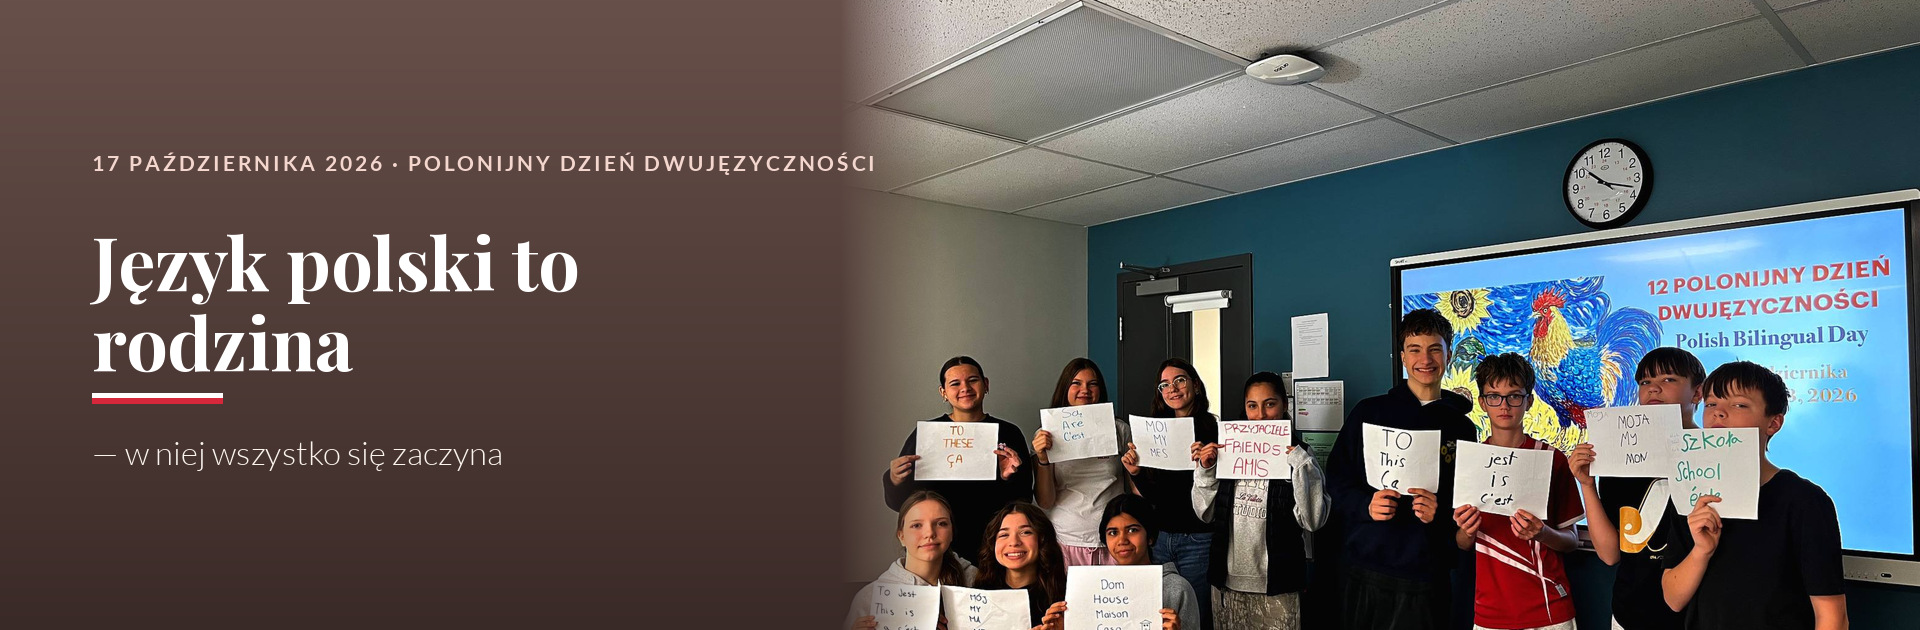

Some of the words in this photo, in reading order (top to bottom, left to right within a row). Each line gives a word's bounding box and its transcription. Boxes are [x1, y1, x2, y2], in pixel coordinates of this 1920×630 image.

[1598, 148, 1611, 159] 12
[1618, 148, 1624, 159] 1
[1584, 155, 1594, 166] 11
[1629, 158, 1636, 168] 2
[1574, 168, 1585, 179] 10
[1633, 172, 1640, 182] 3
[1572, 184, 1579, 194] 9
[1630, 189, 1636, 200] 4
[1577, 199, 1584, 209] 8
[1619, 203, 1626, 213] 5
[1588, 208, 1595, 218] 7
[1603, 210, 1610, 219] 6
[1648, 279, 1669, 296] 12
[1673, 266, 1806, 293] POLONIJNY
[1812, 254, 1890, 282] DZIEŃ
[1658, 288, 1878, 321] DWUJĘZYCZNOŚCI
[1676, 331, 1730, 349] Polish
[1733, 326, 1824, 350] Bilingual
[1828, 325, 1868, 347] Day
[1807, 387, 1857, 403] 2026
[1062, 421, 1084, 431] Are
[1145, 420, 1167, 432] MOI
[1618, 414, 1650, 429] MOJA
[949, 425, 965, 436] TO
[943, 438, 974, 448] THESE
[1153, 434, 1167, 447] MY
[1382, 428, 1412, 450] TO
[1224, 438, 1281, 456] FRIENDS
[1150, 448, 1168, 458] MES
[1626, 452, 1648, 465] MON
[946, 453, 963, 468] ÇA
[1380, 451, 1406, 468] This
[1484, 451, 1518, 468] jest
[1233, 457, 1269, 477] AMIS
[1675, 461, 1721, 482] School
[1491, 471, 1509, 488] is
[1233, 503, 1267, 519] TUDIO
[1101, 579, 1125, 590] Dom
[1093, 594, 1129, 604] House
[875, 603, 895, 616] This
[905, 607, 914, 617] is
[1096, 609, 1129, 619] Maison
